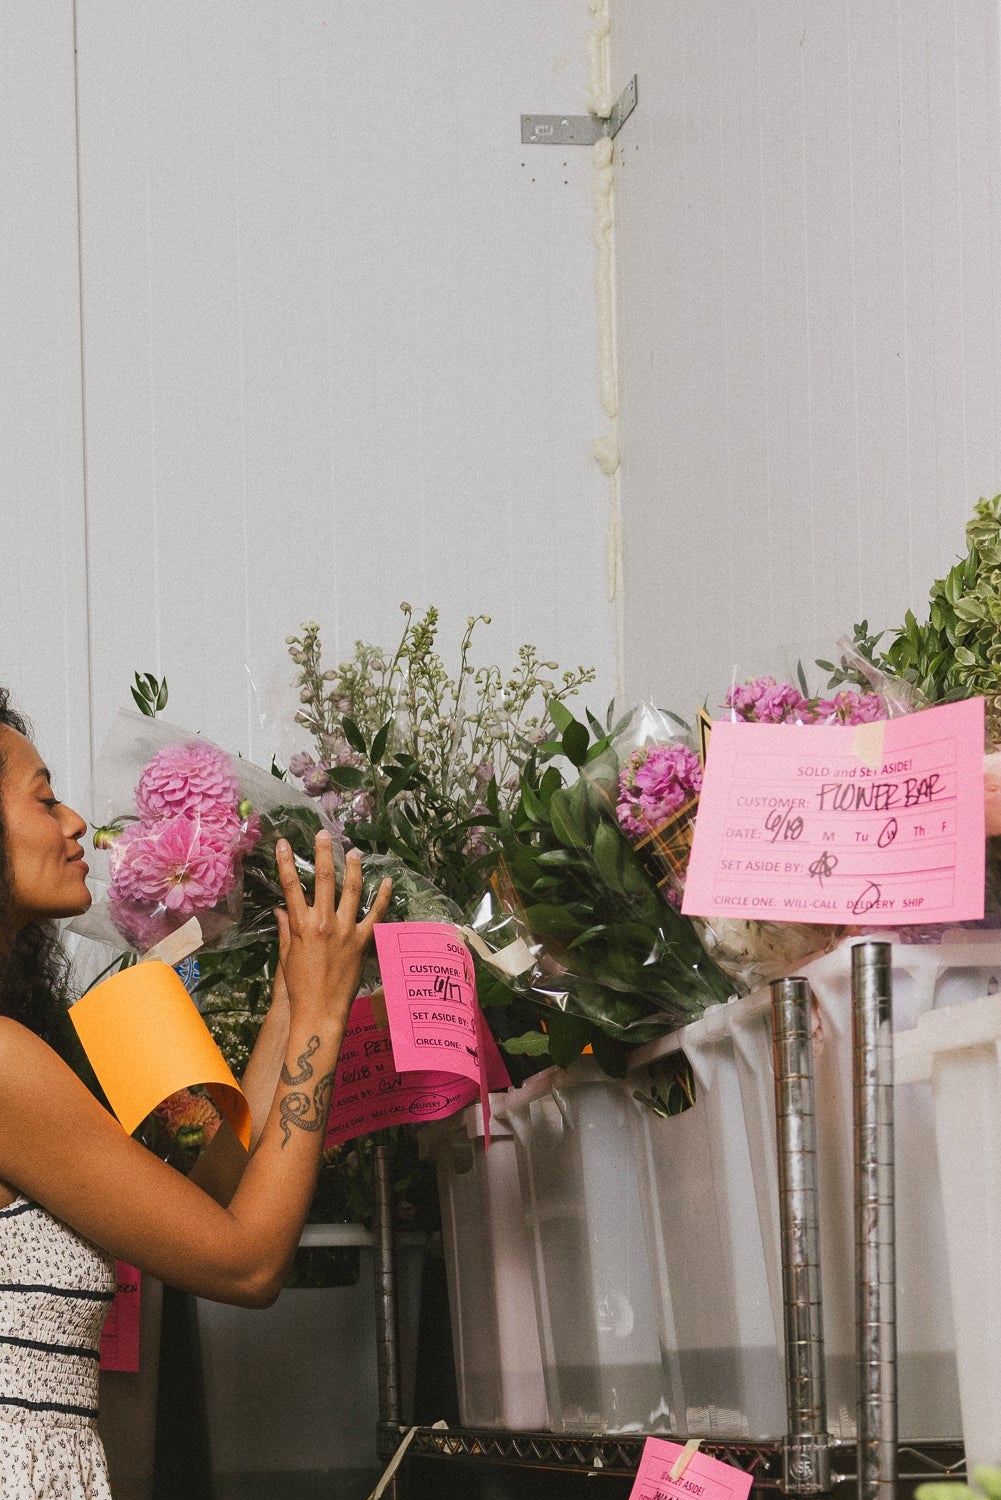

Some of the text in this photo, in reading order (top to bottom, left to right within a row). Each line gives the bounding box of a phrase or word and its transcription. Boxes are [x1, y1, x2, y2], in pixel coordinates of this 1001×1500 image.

[797, 766, 830, 778] SOLD
[833, 767, 856, 778] and
[881, 759, 913, 775] ASIDE!
[901, 773, 946, 808] BAR
[736, 797, 810, 809] CUSTOMER:
[725, 829, 761, 840] DATE:
[822, 831, 836, 842] M
[854, 832, 868, 842] Tu
[913, 825, 926, 837] Th
[941, 821, 947, 833] F
[720, 860, 804, 873] SET ASIDE BY:
[714, 895, 924, 909] CIRCLE ONE: WILL-CALL DELIVERY SHIP
[446, 943, 465, 957] SOLD
[409, 965, 461, 978] CUSTOMER:
[408, 988, 437, 998] DATE:
[412, 1012, 470, 1028] SET ASIDE BY:
[345, 1025, 362, 1038] OLD
[416, 1038, 462, 1050] CIRCLE ONE:
[361, 1089, 375, 1099] BY:
[410, 1101, 441, 1110] DELIVERY
[683, 1481, 704, 1497] ASIDE!
